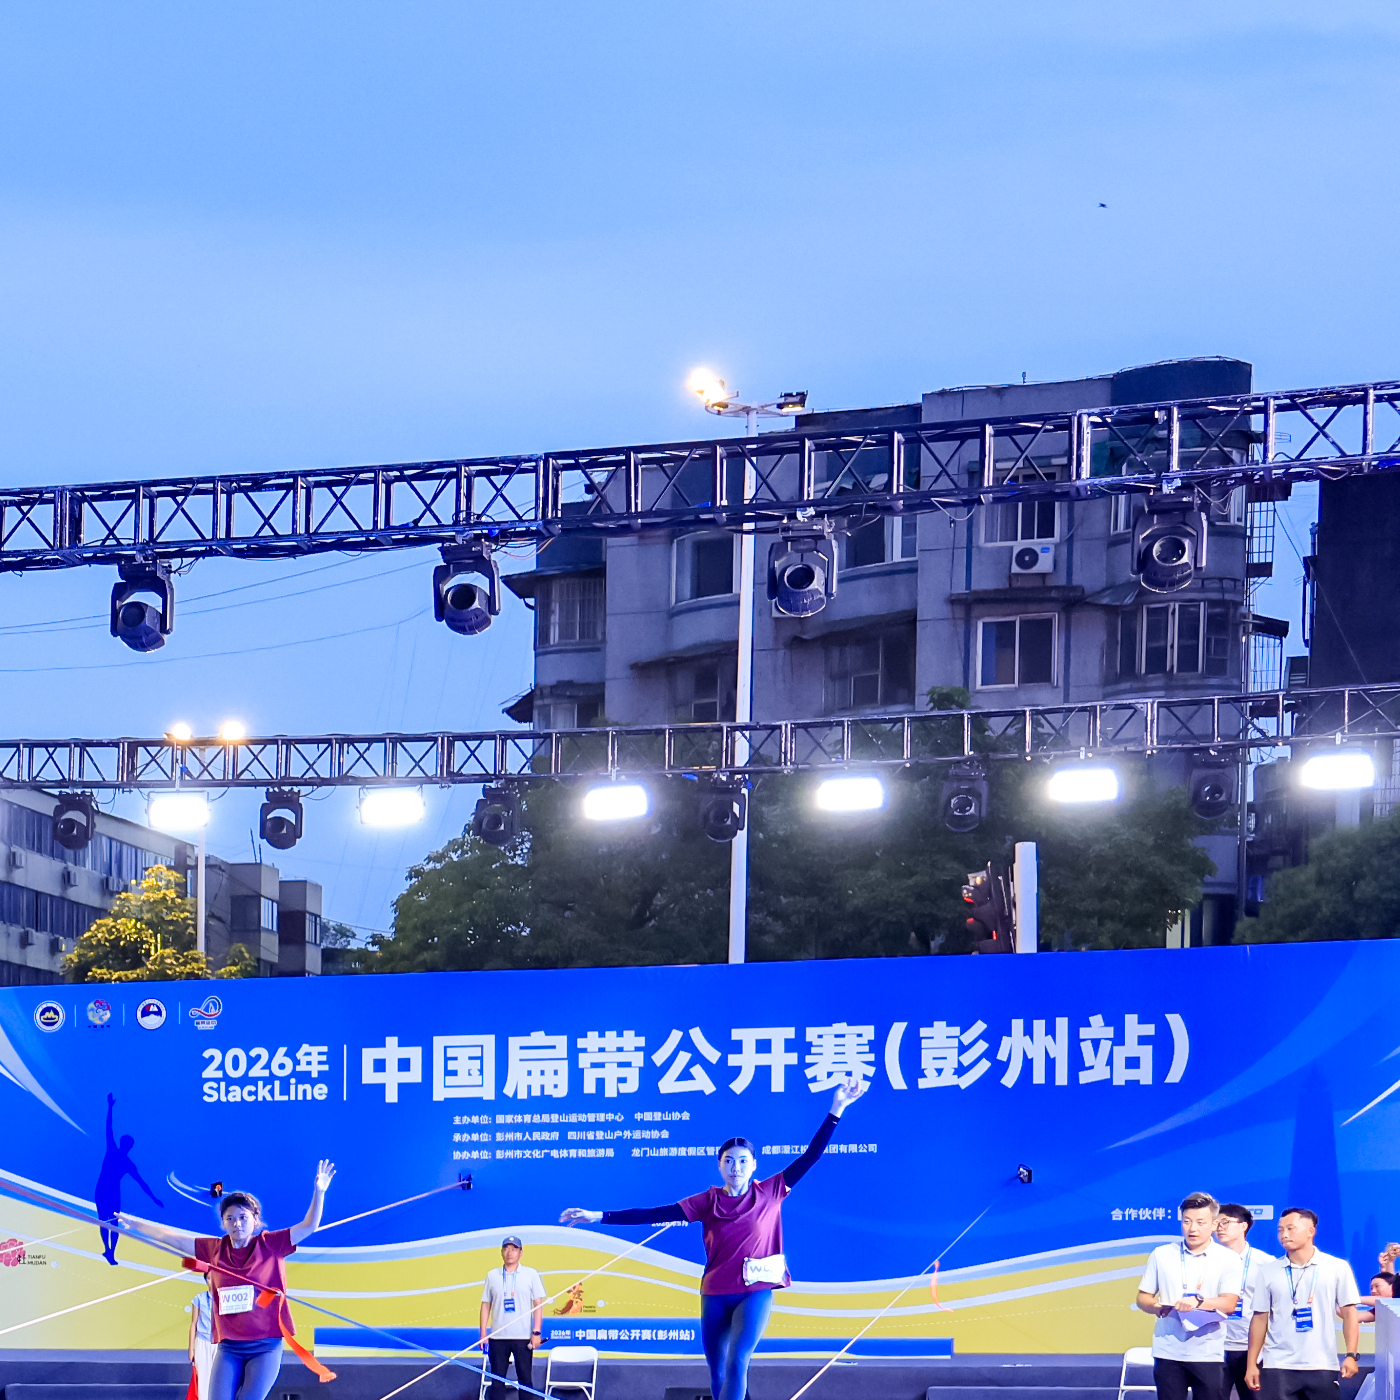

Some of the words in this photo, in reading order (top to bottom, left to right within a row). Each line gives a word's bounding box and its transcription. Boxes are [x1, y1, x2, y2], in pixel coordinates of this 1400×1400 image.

[201, 1044, 329, 1078] 2026年
[361, 1013, 1190, 1103] 中国扁带公开赛(彭州站)
[202, 1078, 328, 1102] SlackLine
[453, 1115, 492, 1125] 主办单位：
[634, 1111, 690, 1122] 中国登山协会
[453, 1132, 492, 1142] 承办单位：
[496, 1131, 559, 1141] 彭州市人民政府
[567, 1129, 670, 1140] 四川省登山户外运动协会
[453, 1150, 492, 1160] 协办单位：
[1111, 1207, 1172, 1221] 合作伙伴：
[575, 1328, 696, 1341] 中国扁带公开赛(彭州站)
